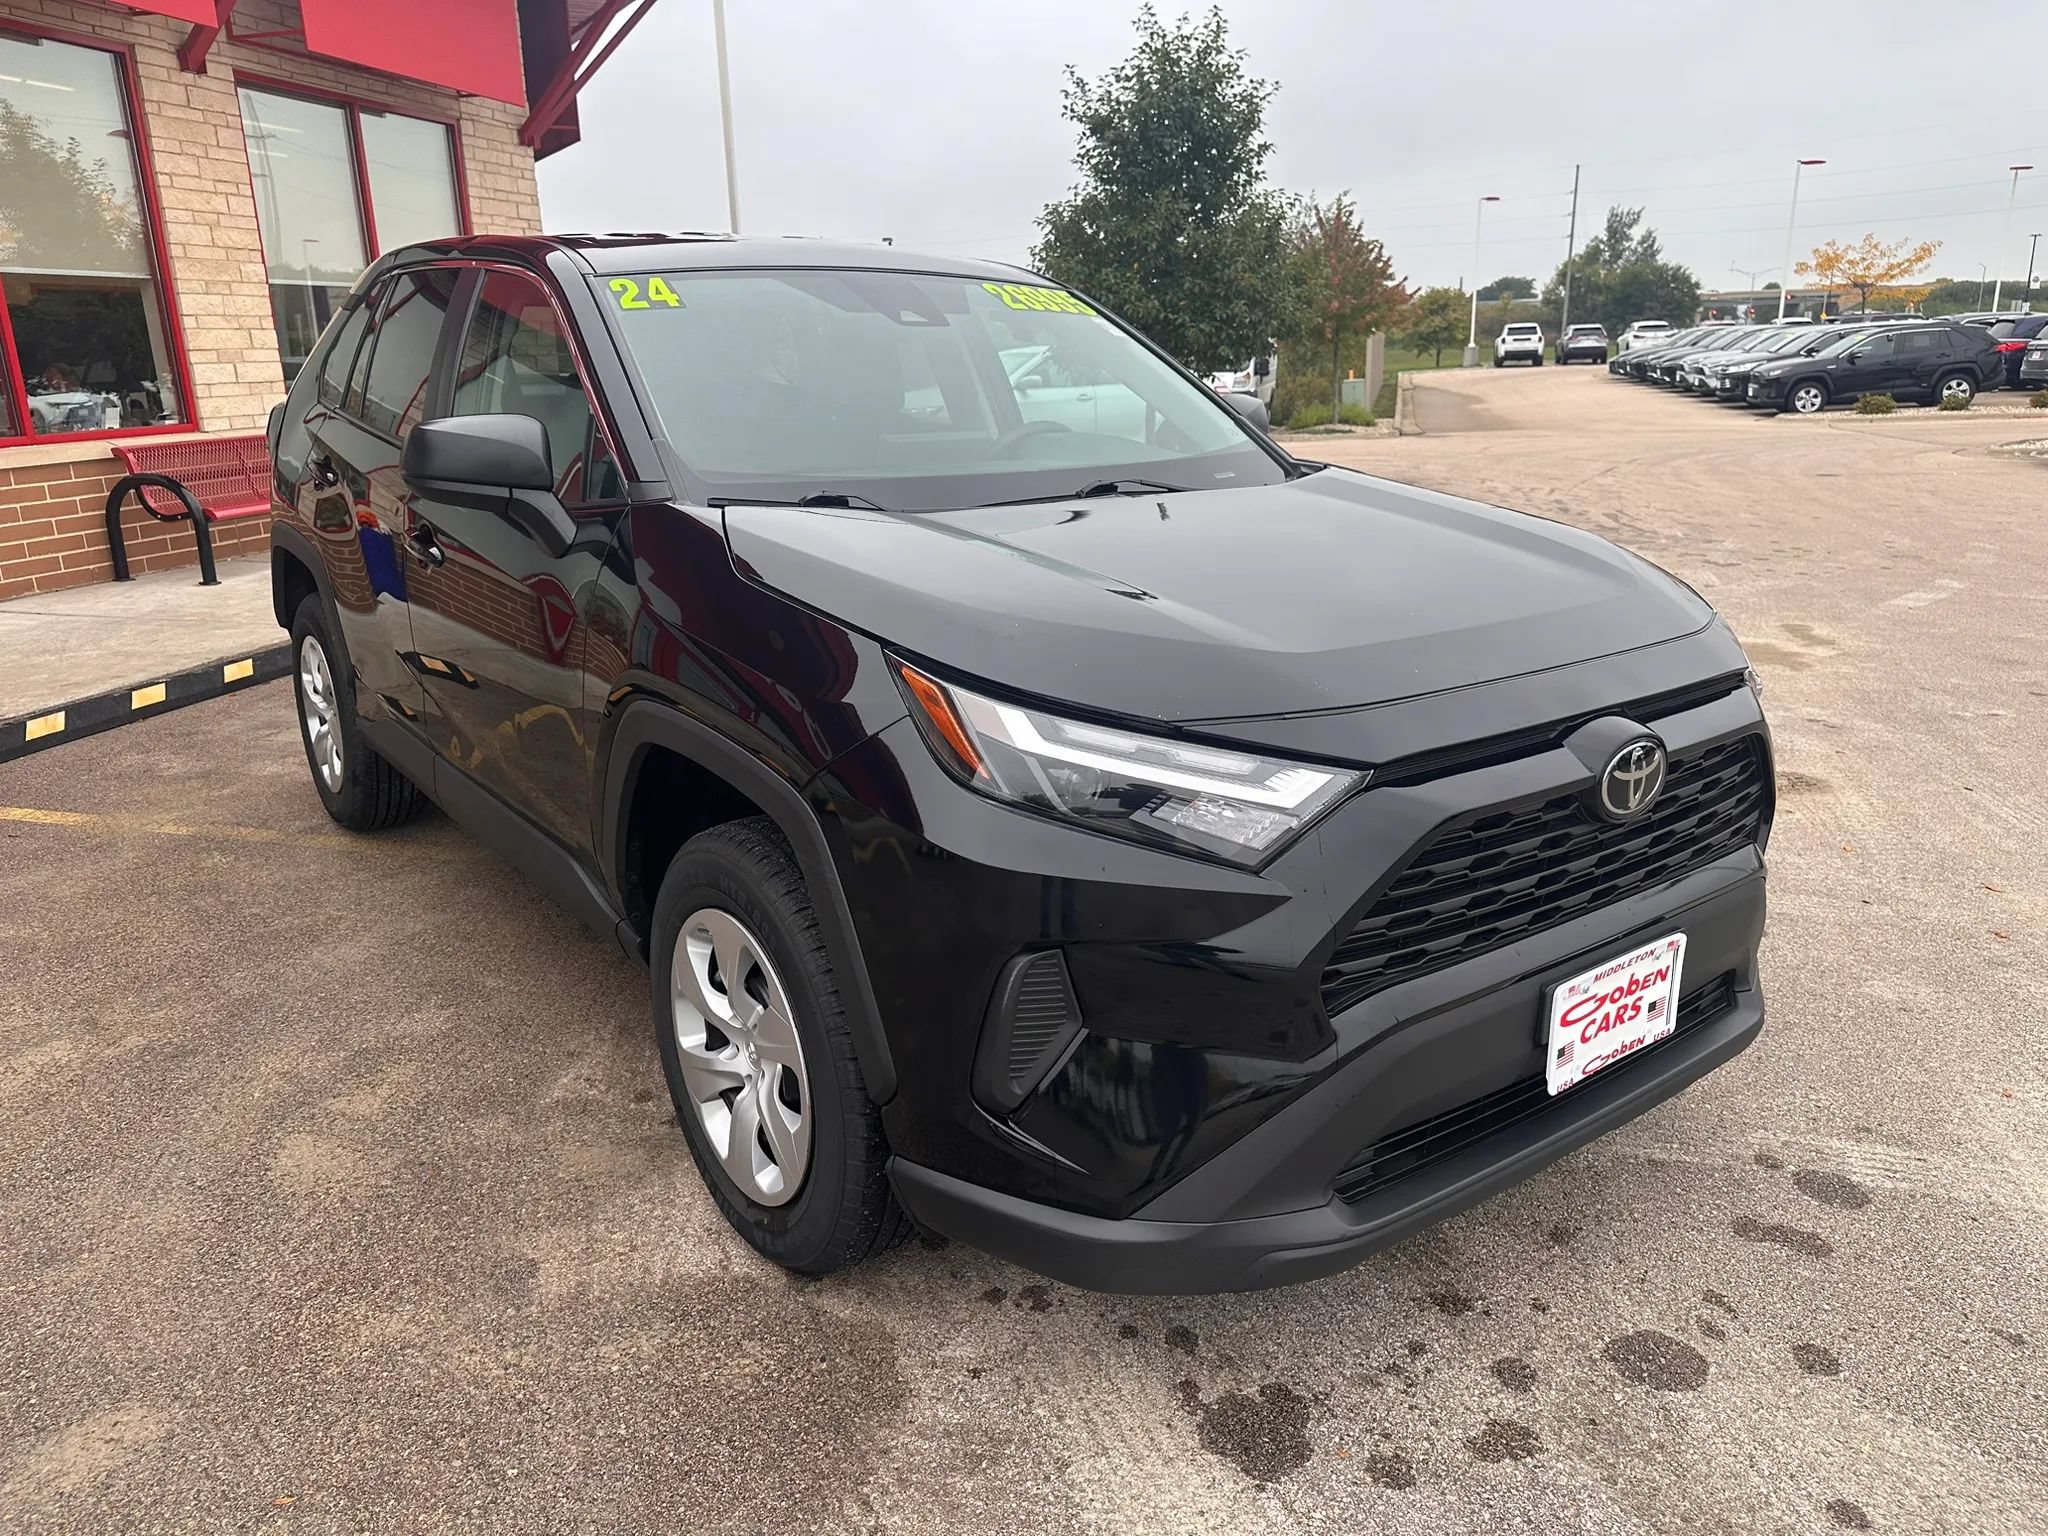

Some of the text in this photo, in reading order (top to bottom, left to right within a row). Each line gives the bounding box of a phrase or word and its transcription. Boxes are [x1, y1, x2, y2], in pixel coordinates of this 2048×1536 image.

[608, 276, 681, 309] 24
[981, 282, 1098, 315] 26995
[1593, 948, 1657, 984] MIDDLETON
[1580, 996, 1645, 1044] CARS
[1556, 1077, 1575, 1093] USA
[1653, 1027, 1671, 1041] USA
